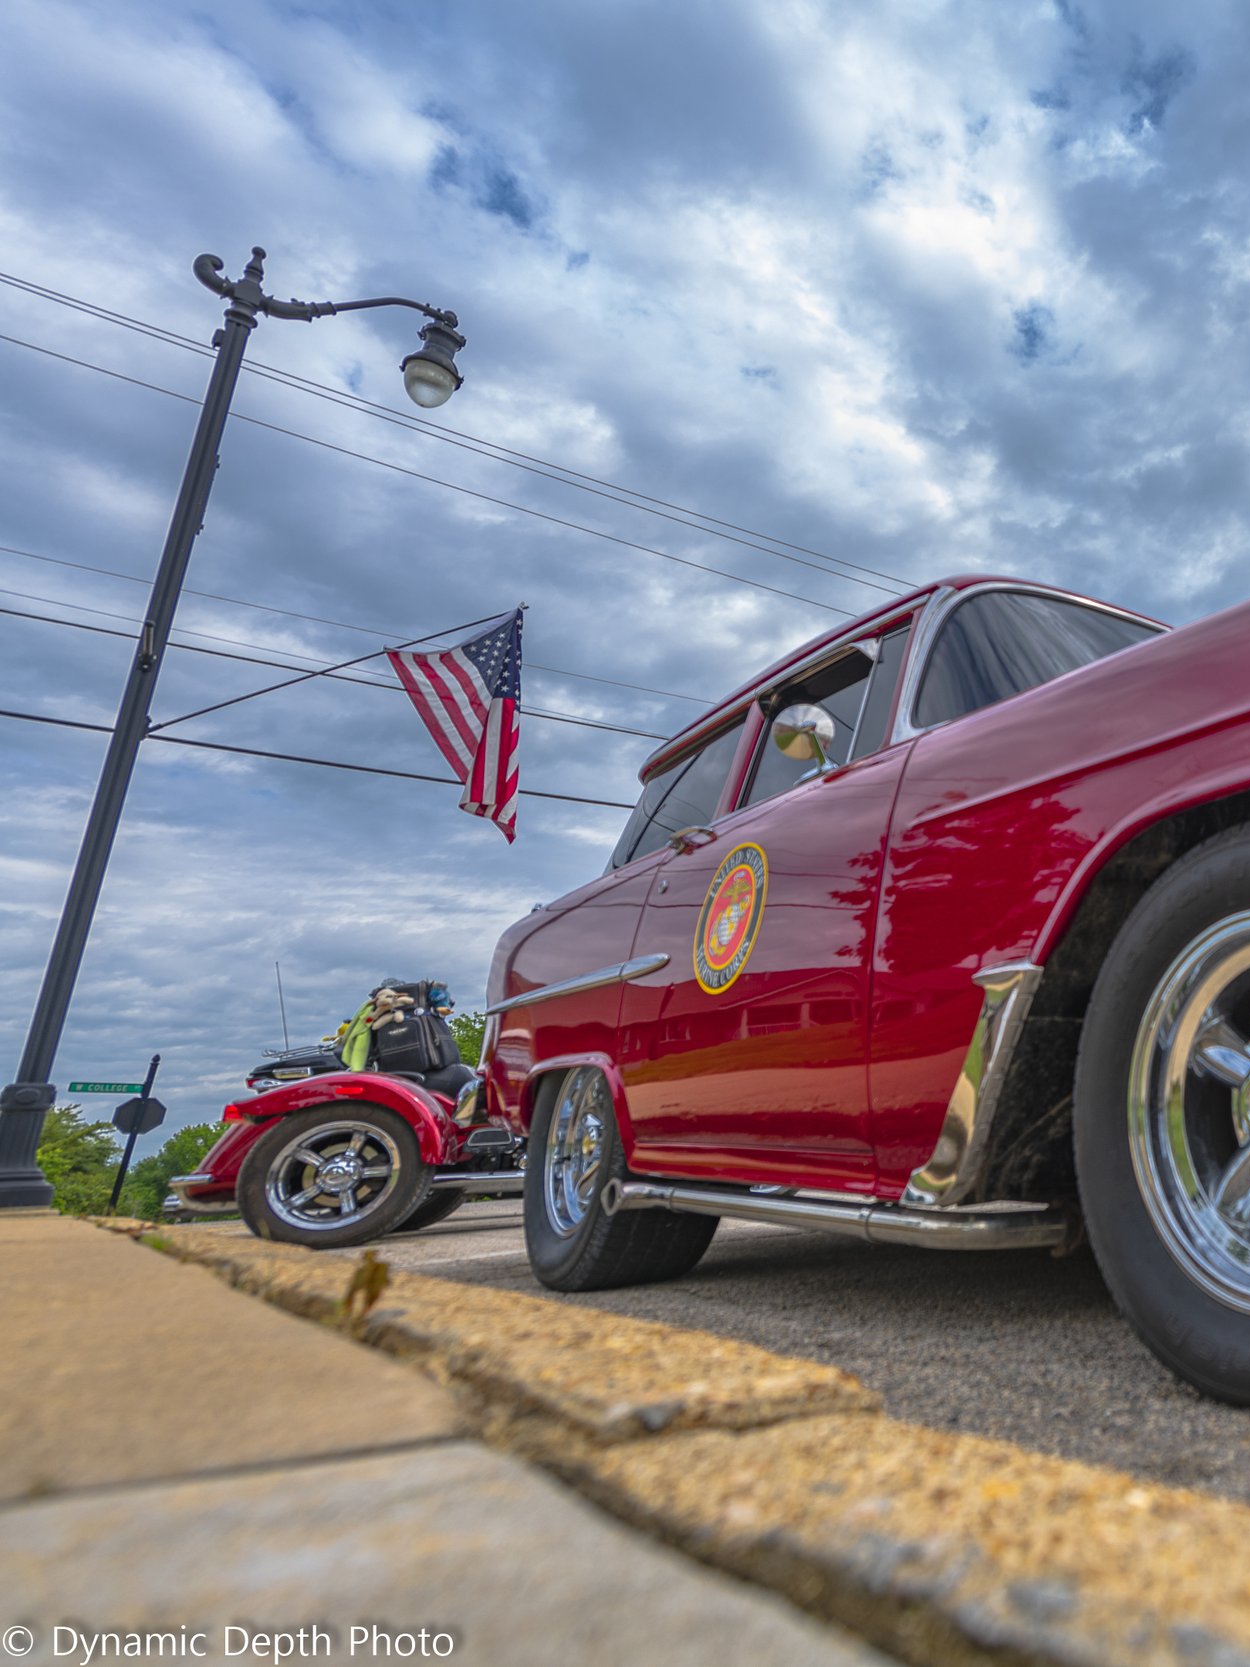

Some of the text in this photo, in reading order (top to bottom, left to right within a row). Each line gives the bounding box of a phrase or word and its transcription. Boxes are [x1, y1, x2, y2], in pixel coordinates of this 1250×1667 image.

[710, 849, 764, 897] UNITED STATES
[696, 940, 750, 988] MARINE CORPS
[88, 1084, 128, 1092] COLLEGE
